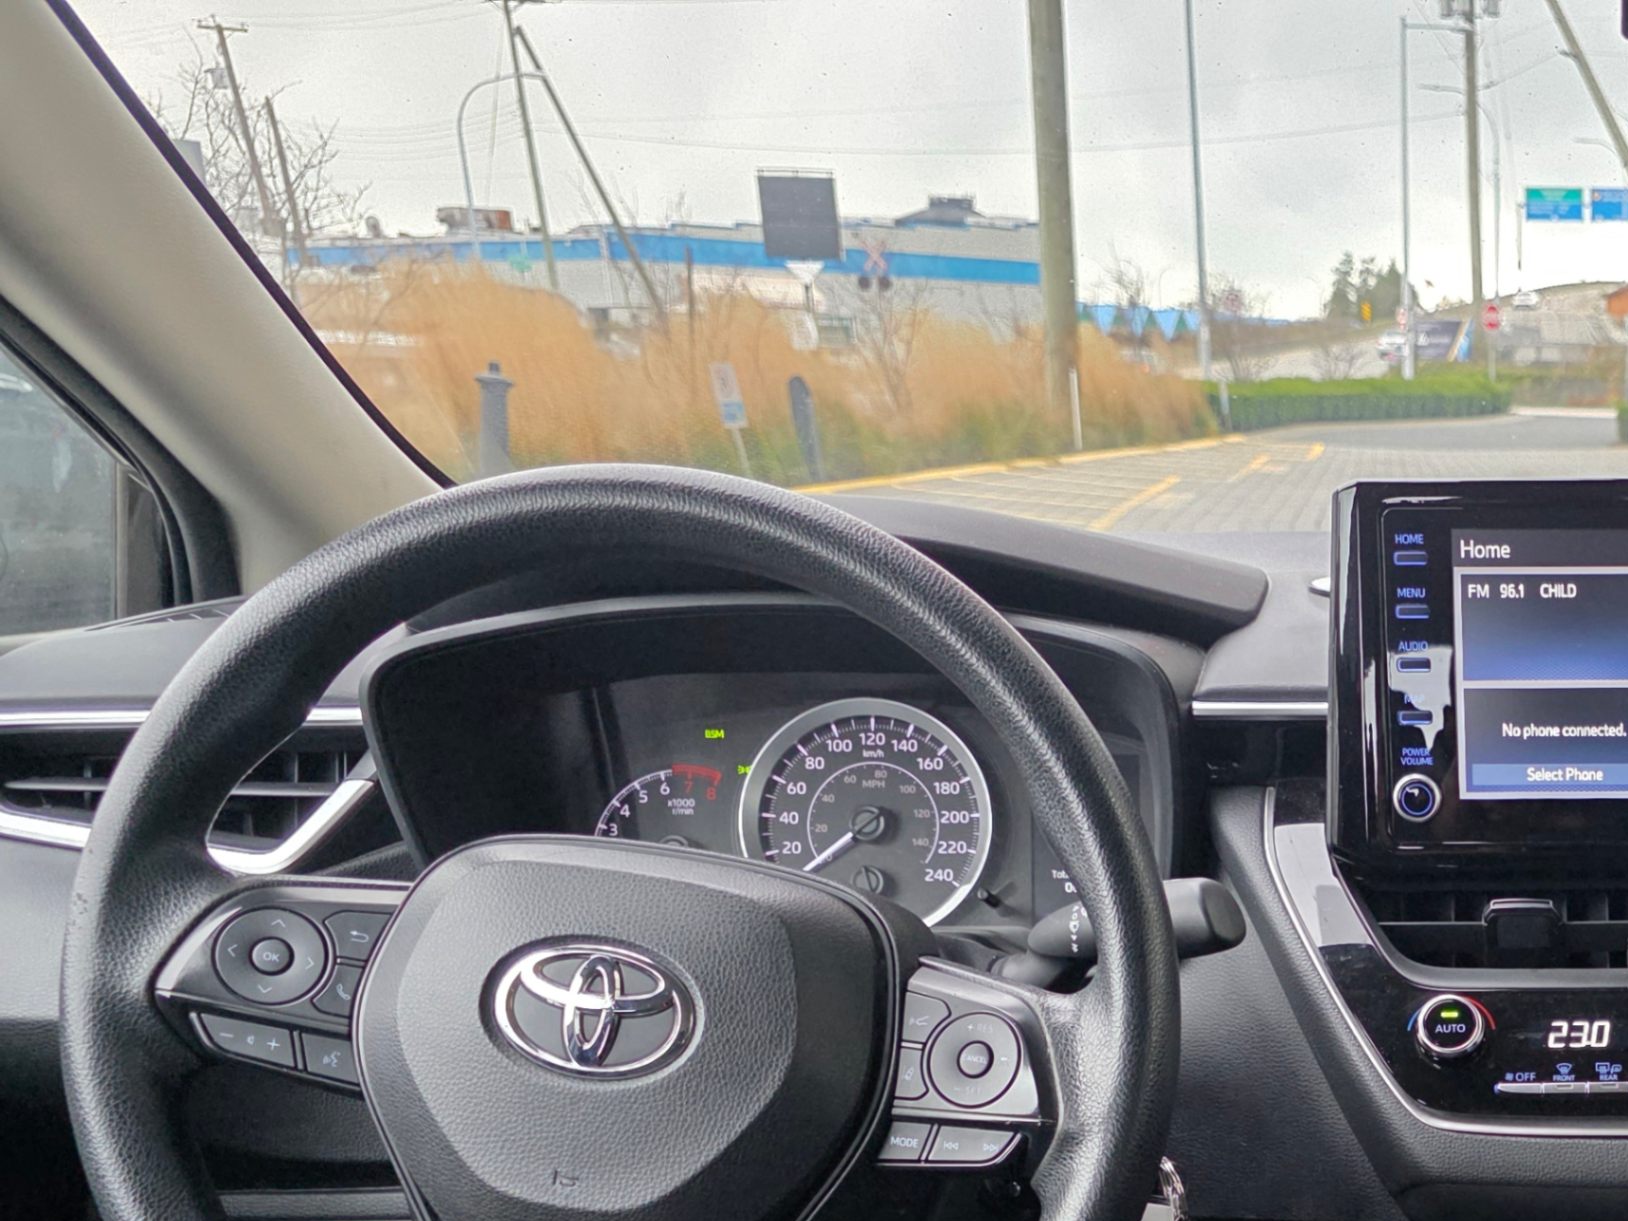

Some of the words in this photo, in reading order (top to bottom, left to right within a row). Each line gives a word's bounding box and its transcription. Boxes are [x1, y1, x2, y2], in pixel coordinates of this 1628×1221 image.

[1395, 534, 1424, 544] HOME
[1460, 540, 1511, 559] Home
[1397, 587, 1425, 598] MENU
[1468, 584, 1490, 598] FM
[1500, 584, 1525, 598] 96.1
[1540, 584, 1577, 598] CHILD
[1398, 641, 1428, 651] AUDIO
[1502, 723, 1521, 737] No
[1523, 723, 1560, 739] phone
[1562, 723, 1627, 737] connected.
[859, 733, 885, 745] 120
[826, 739, 852, 752] 100
[891, 739, 918, 752] 140
[863, 750, 884, 758] km/h
[1402, 747, 1430, 757] POWER
[805, 757, 825, 770] 80
[917, 758, 943, 770] 160
[1401, 756, 1433, 766] VOLUME
[844, 775, 857, 784] 60
[874, 770, 887, 778] 80
[1527, 768, 1563, 781] Select
[1566, 767, 1603, 781] Phone
[660, 782, 670, 795] 6
[684, 781, 693, 793] 7
[787, 782, 807, 795] 60
[862, 780, 885, 788] MPH
[900, 785, 916, 794] 100
[934, 782, 960, 795] 180
[639, 791, 648, 804] 5
[707, 788, 716, 800] 8
[822, 794, 835, 803] 40
[668, 799, 695, 807] x1000
[620, 804, 631, 817] 4
[913, 809, 930, 818] 120
[780, 812, 799, 824] 40
[941, 811, 969, 824] 200
[609, 824, 618, 836] 3
[815, 824, 828, 833] 20
[782, 842, 802, 854] 20
[912, 838, 929, 846] 140
[938, 841, 967, 854] 220
[925, 869, 954, 882] 240
[263, 952, 279, 962] OK
[1435, 1023, 1466, 1034] AUTO
[963, 1053, 987, 1065] CANCEL
[1516, 1072, 1536, 1082] OFF
[890, 1136, 919, 1148] MODE
